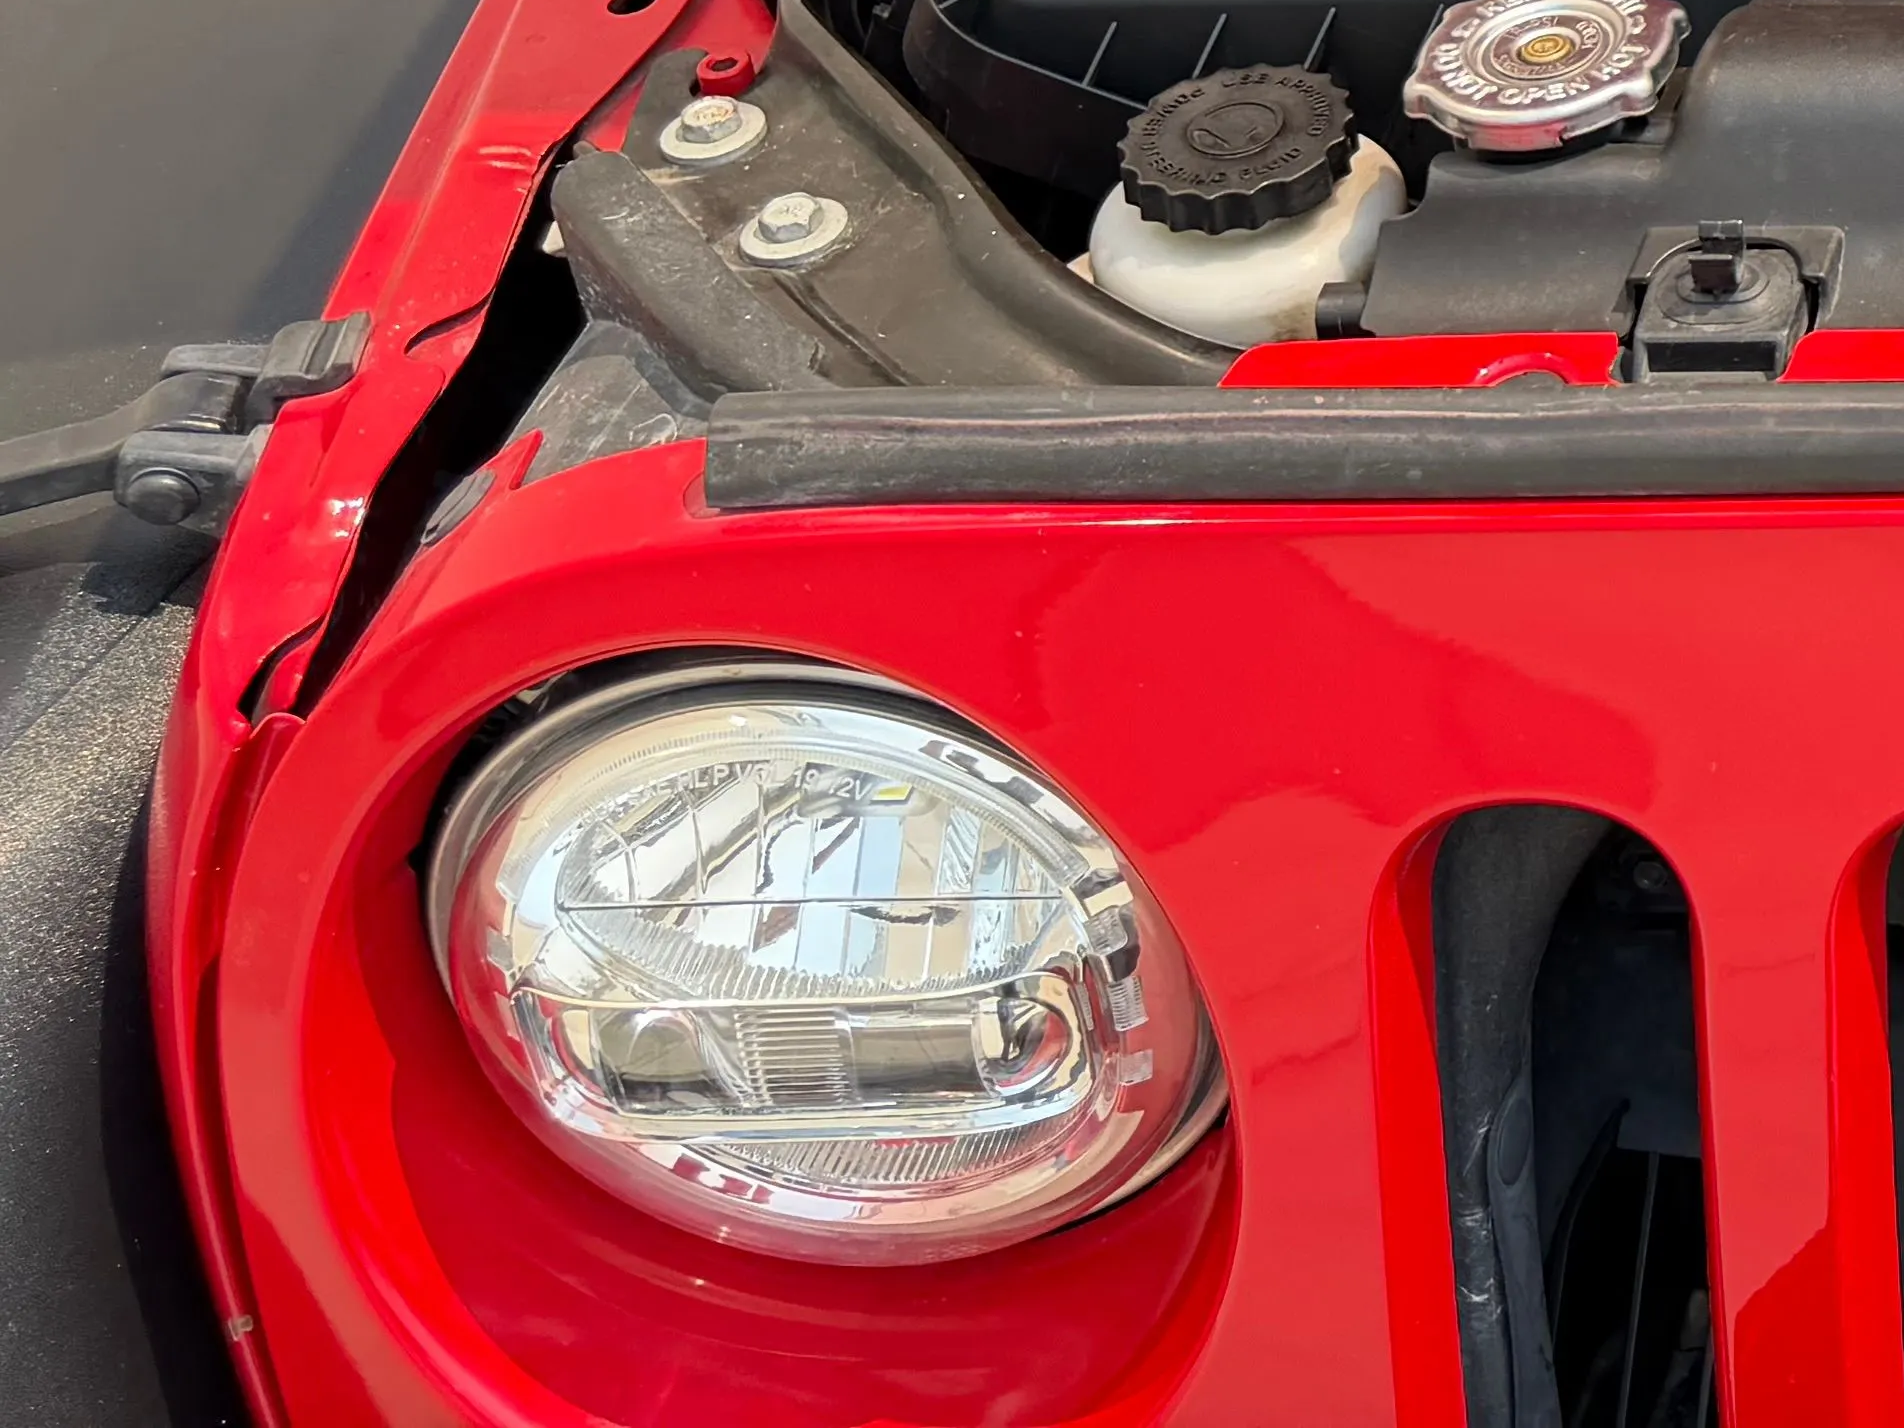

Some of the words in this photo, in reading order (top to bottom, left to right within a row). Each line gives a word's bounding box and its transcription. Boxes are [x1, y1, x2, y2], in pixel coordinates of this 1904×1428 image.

[1221, 72, 1270, 88] USE
[1275, 75, 1330, 138] APPROVED
[1497, 76, 1590, 105] OPEN
[1592, 42, 1651, 81] HOT
[1140, 142, 1227, 187] STEERING
[1239, 146, 1303, 180] FLUID
